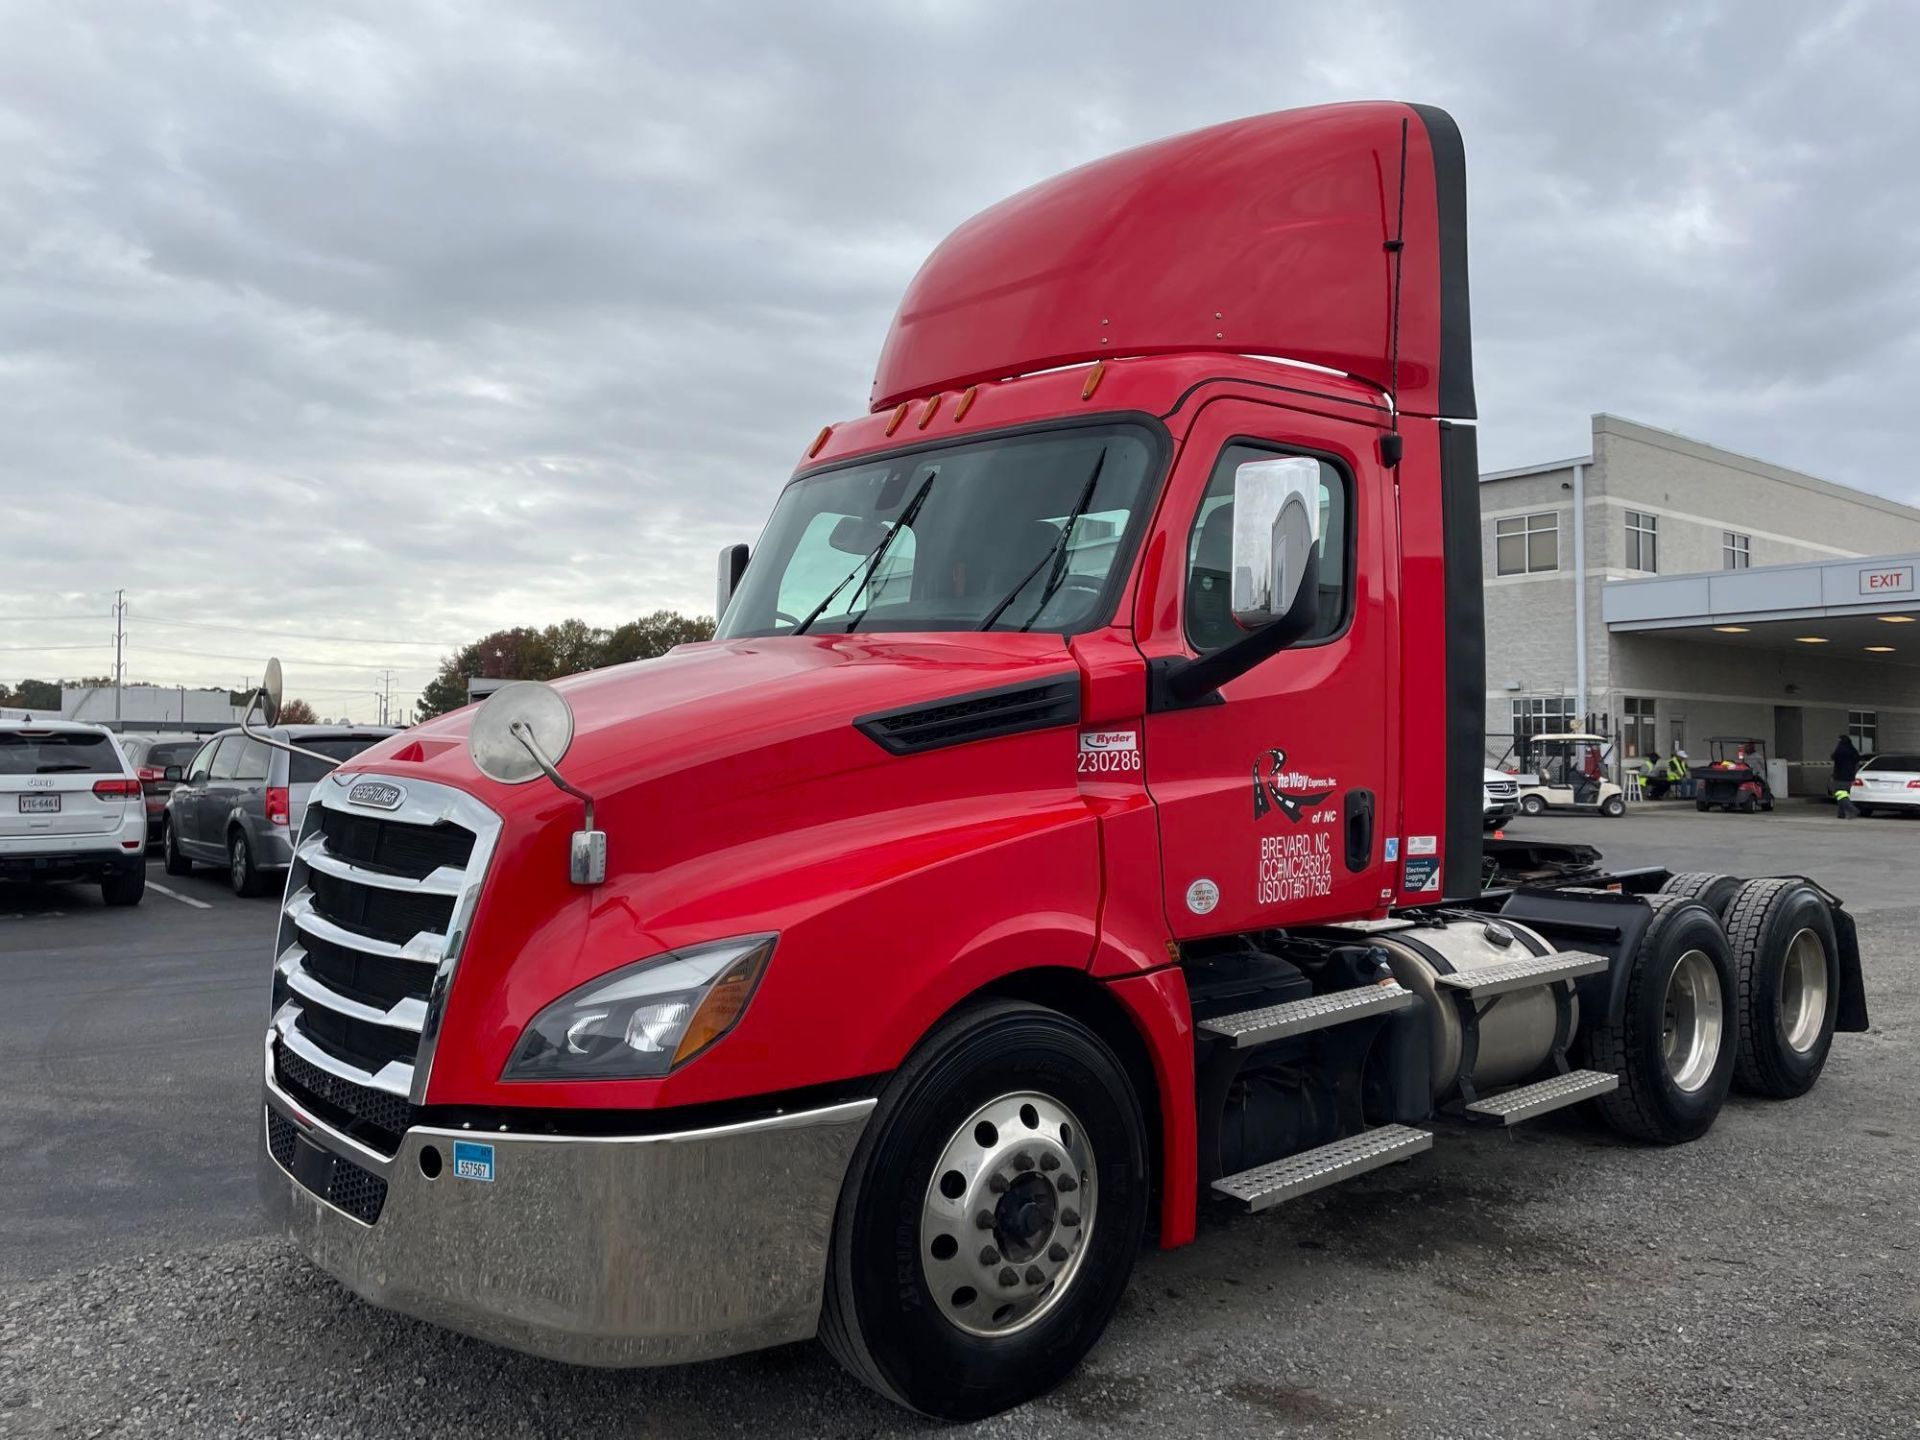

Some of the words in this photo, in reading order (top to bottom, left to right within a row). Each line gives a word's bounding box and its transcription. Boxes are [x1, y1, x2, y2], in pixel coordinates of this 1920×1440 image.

[1870, 573, 1903, 588] EXIT
[1096, 733, 1131, 744] Ryder
[1077, 750, 1140, 772] 230286
[351, 785, 399, 803] FREIGHTLINER
[1312, 812, 1321, 823] of
[1324, 810, 1337, 823] NC
[1261, 834, 1312, 859] BREVARD,
[1315, 832, 1330, 854] NC
[1259, 853, 1332, 882] ICC#MC295812
[1405, 874, 1426, 882] Logging
[1258, 875, 1332, 904] USDOT#617562
[460, 1161, 487, 1177] 557567
